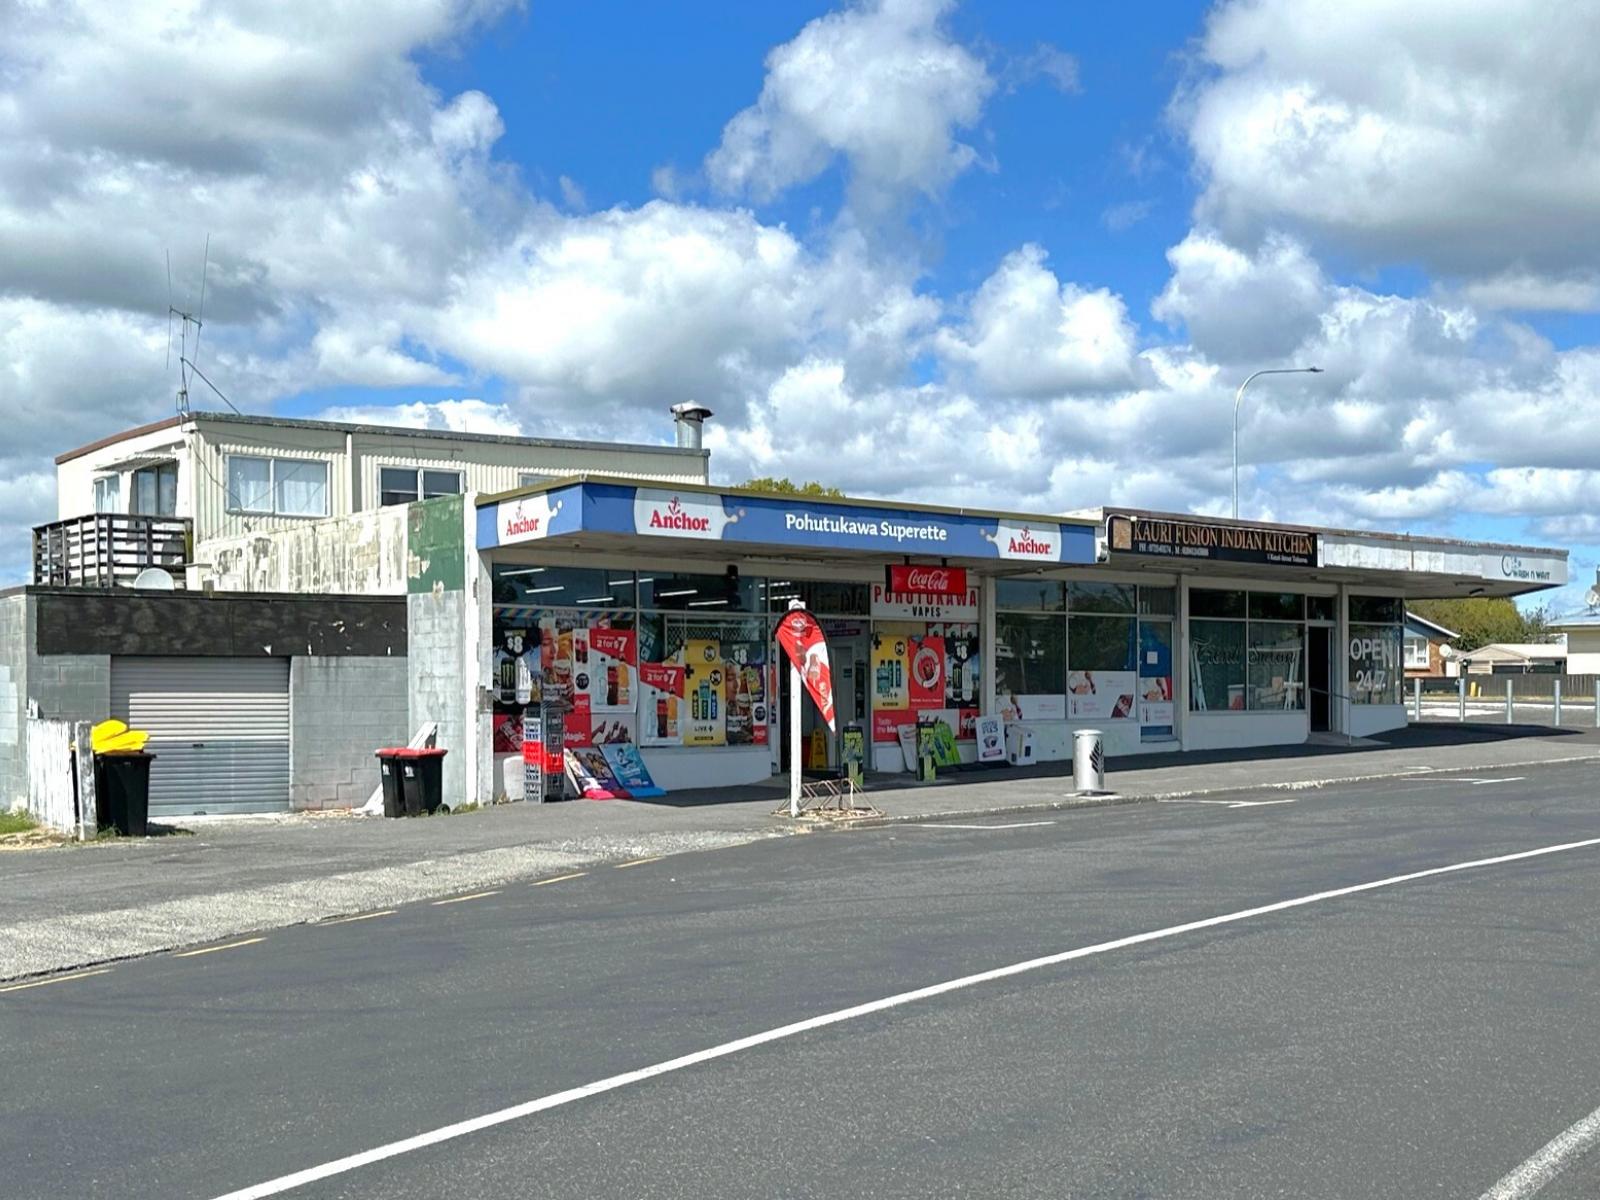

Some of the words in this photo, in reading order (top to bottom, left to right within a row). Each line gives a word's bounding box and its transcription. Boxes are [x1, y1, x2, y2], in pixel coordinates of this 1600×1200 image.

[506, 517, 539, 536] Anchor
[649, 509, 710, 531] Anchor
[785, 513, 878, 535] Pohutukawa
[880, 522, 947, 542] Superette
[1008, 537, 1051, 554] Anchor
[1134, 521, 1172, 543] KAURI
[1175, 524, 1218, 547] FUSION
[1221, 528, 1262, 550] INDIAN
[1265, 532, 1313, 555] KITCHEN
[912, 606, 942, 617] VAPES
[1350, 638, 1393, 669] OPEN
